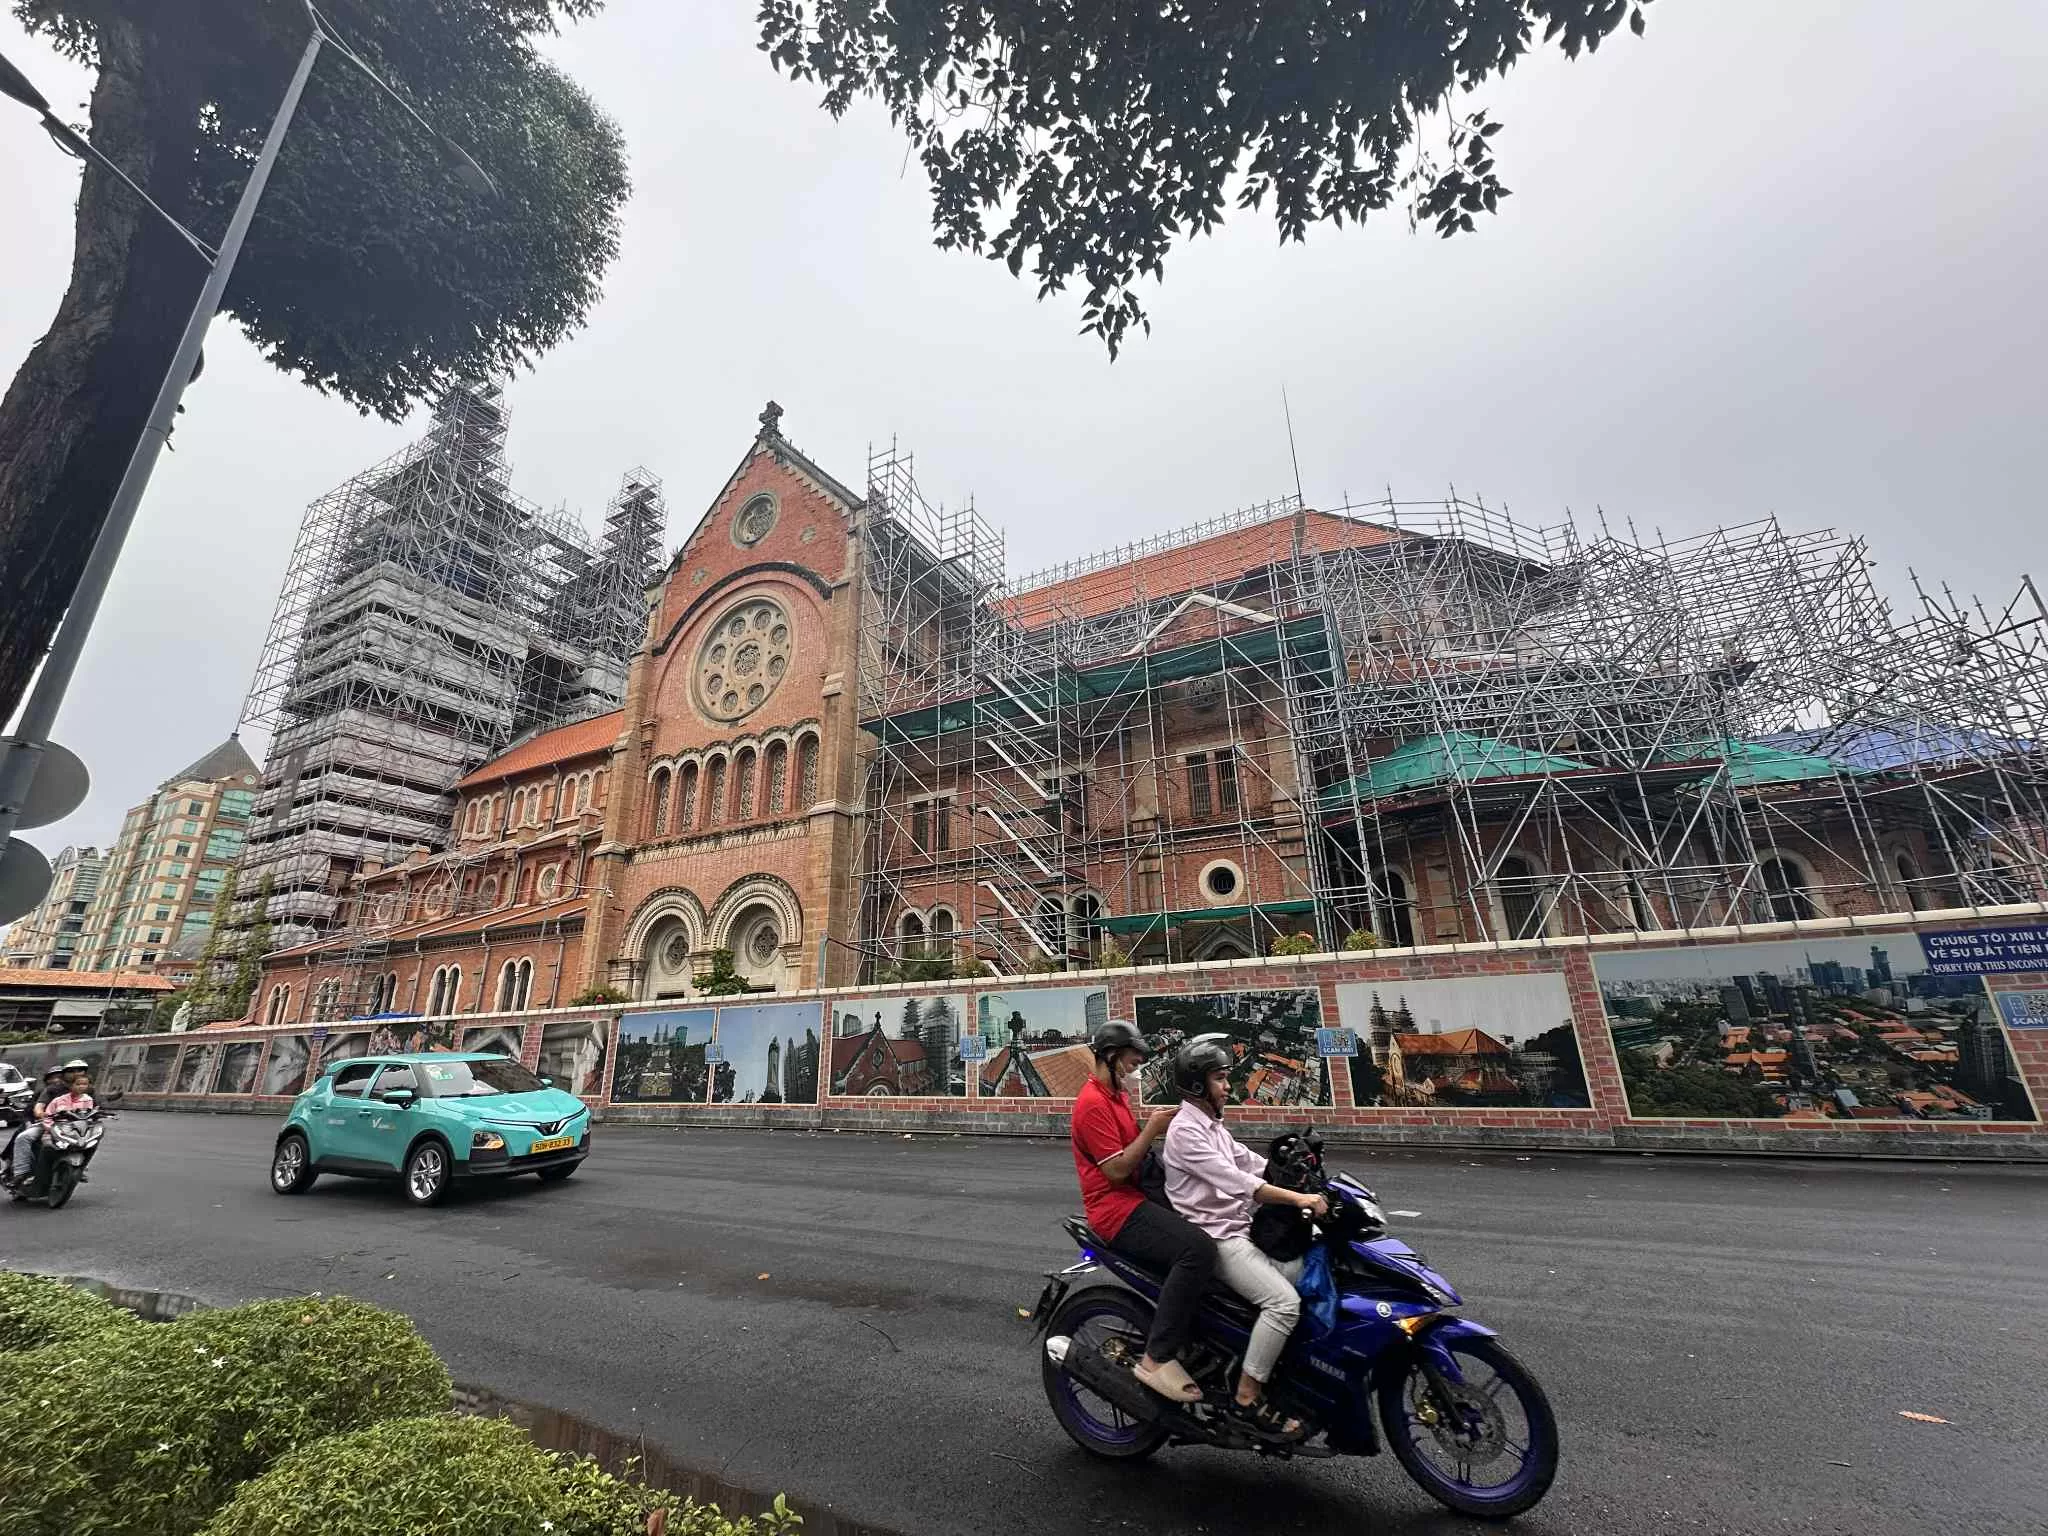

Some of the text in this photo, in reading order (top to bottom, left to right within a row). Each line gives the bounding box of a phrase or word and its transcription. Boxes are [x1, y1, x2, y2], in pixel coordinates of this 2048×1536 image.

[2009, 931, 2035, 942] XIN
[1932, 963, 1962, 973] SORRY
[1963, 961, 1983, 972] FOR
[1983, 960, 2006, 971] THIS
[2012, 1017, 2044, 1025] SCAN
[1310, 1355, 1346, 1381] YAMAHA
